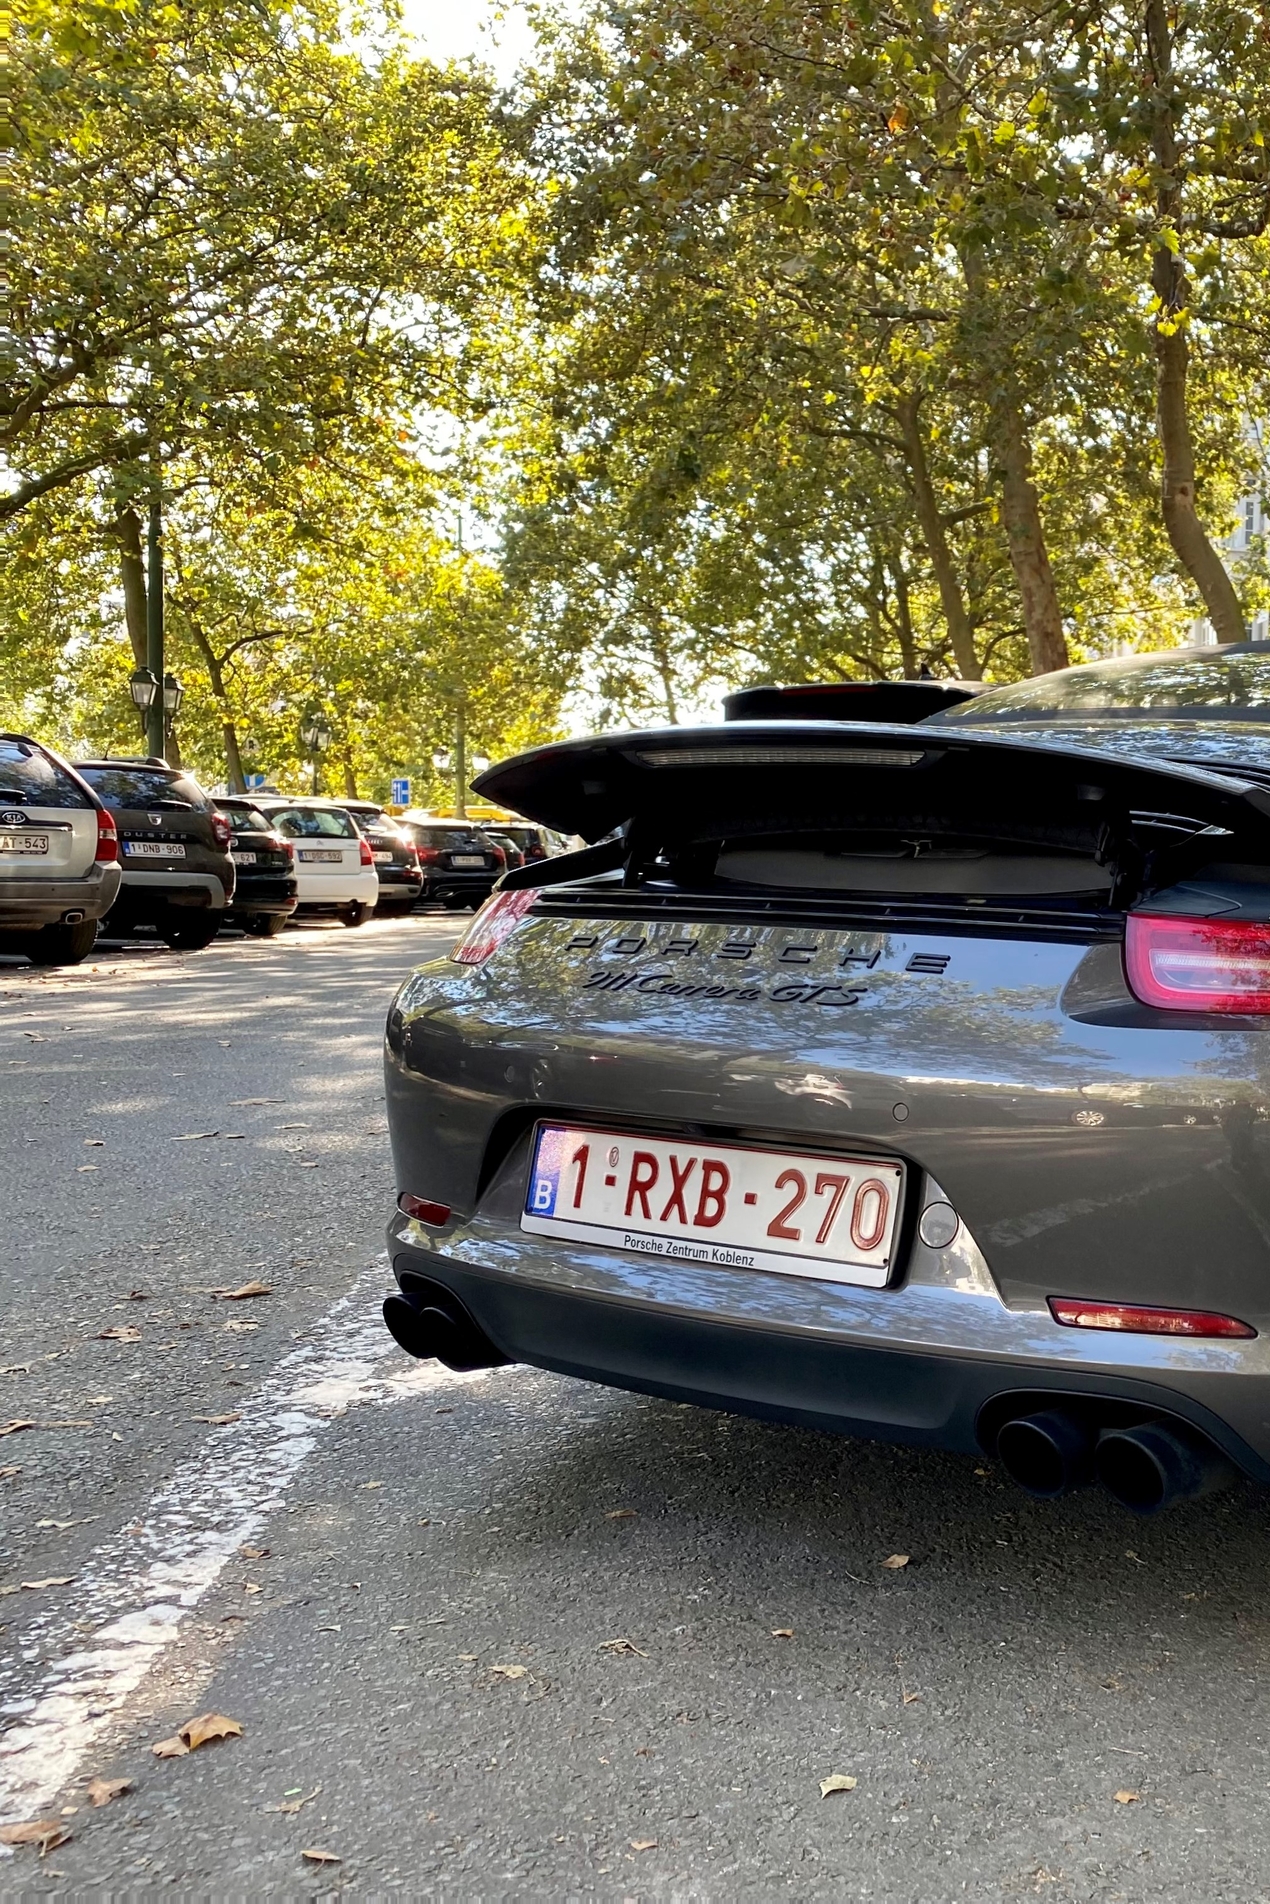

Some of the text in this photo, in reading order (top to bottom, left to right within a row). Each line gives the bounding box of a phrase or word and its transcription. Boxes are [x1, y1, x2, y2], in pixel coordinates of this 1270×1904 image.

[0, 838, 46, 849] AT-543
[123, 831, 187, 840] DUSTER
[564, 935, 951, 975] PORSCHE
[582, 970, 869, 1006] 911 Carrera GTS
[534, 1179, 553, 1210] B
[624, 1234, 755, 1267] Porsche Zentrum Koblenz
